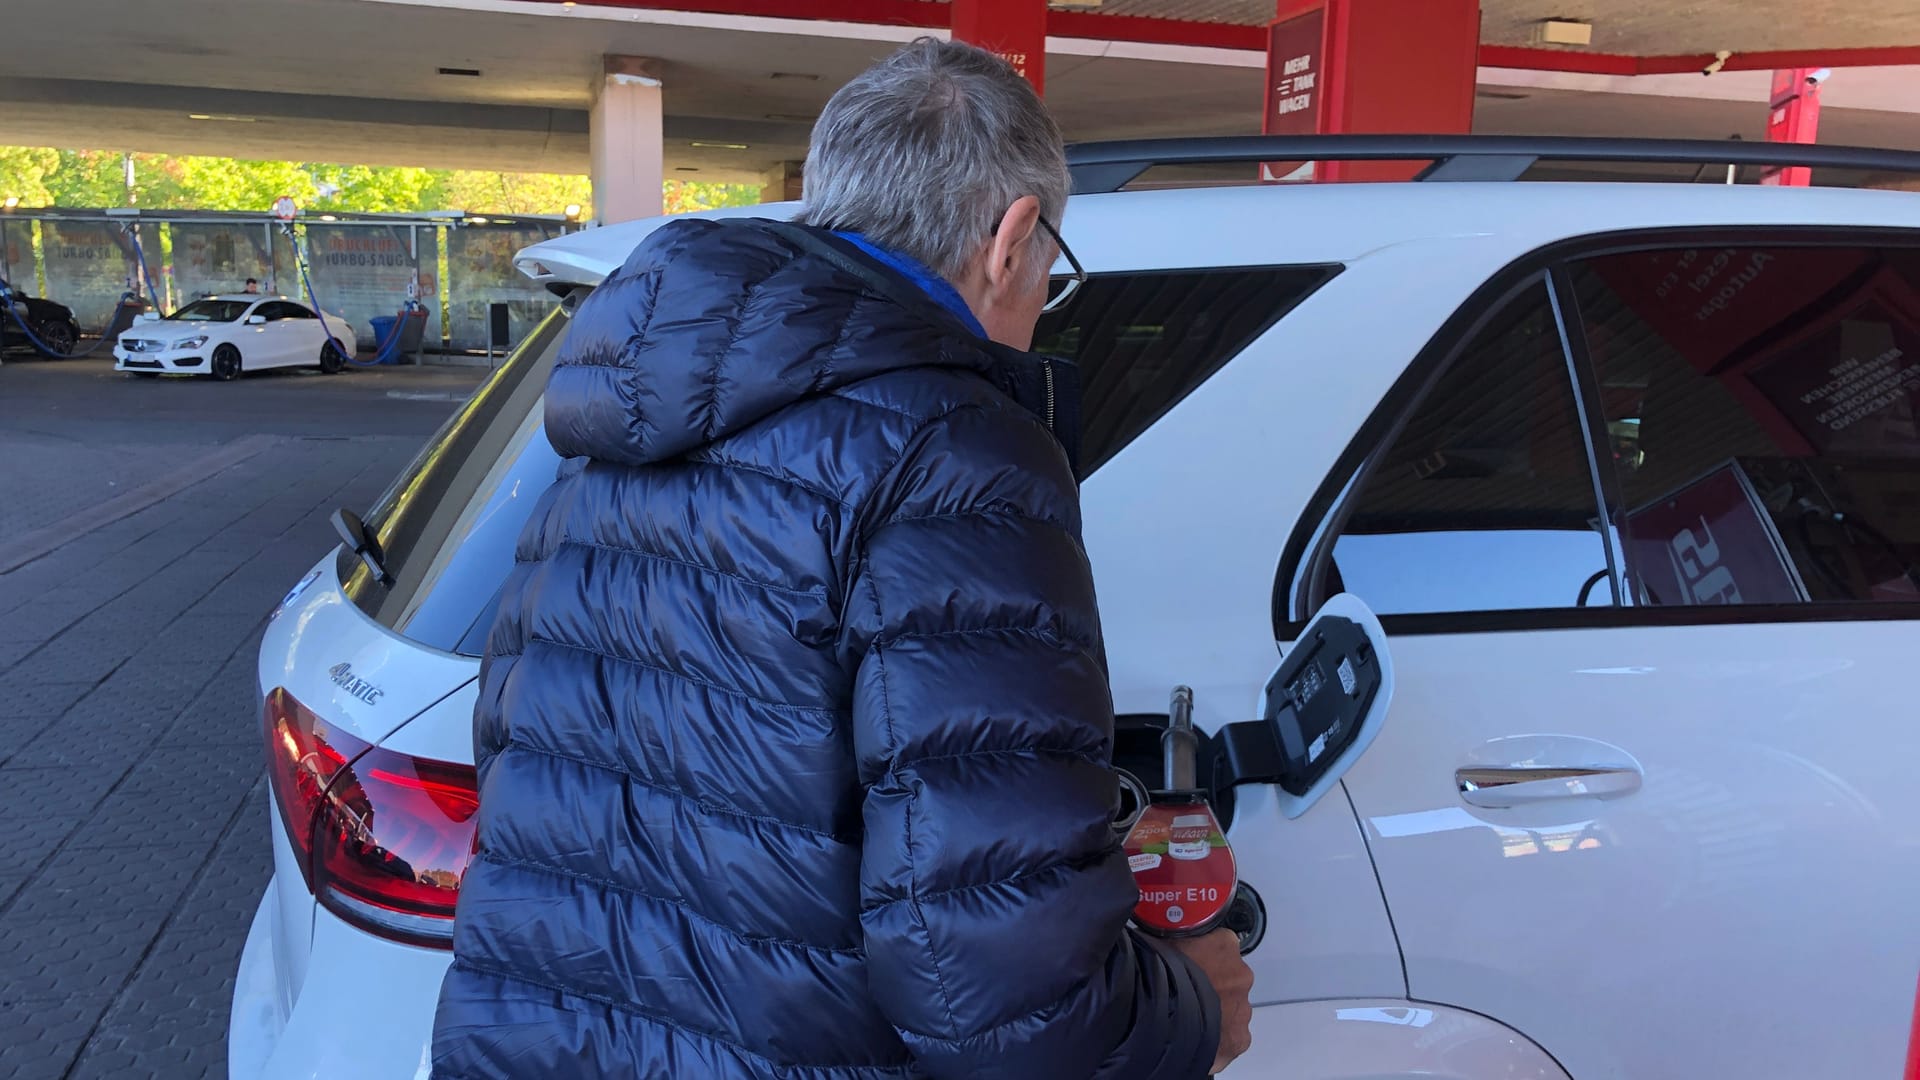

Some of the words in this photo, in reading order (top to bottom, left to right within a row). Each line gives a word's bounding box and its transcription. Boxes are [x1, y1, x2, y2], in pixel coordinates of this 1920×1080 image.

[1283, 55, 1311, 76] MEHR
[1293, 72, 1316, 92] TANK
[1278, 93, 1311, 115] WAGEN
[329, 662, 384, 706] 4MATIC
[1186, 888, 1218, 902] E10
[1168, 909, 1181, 917] E10
